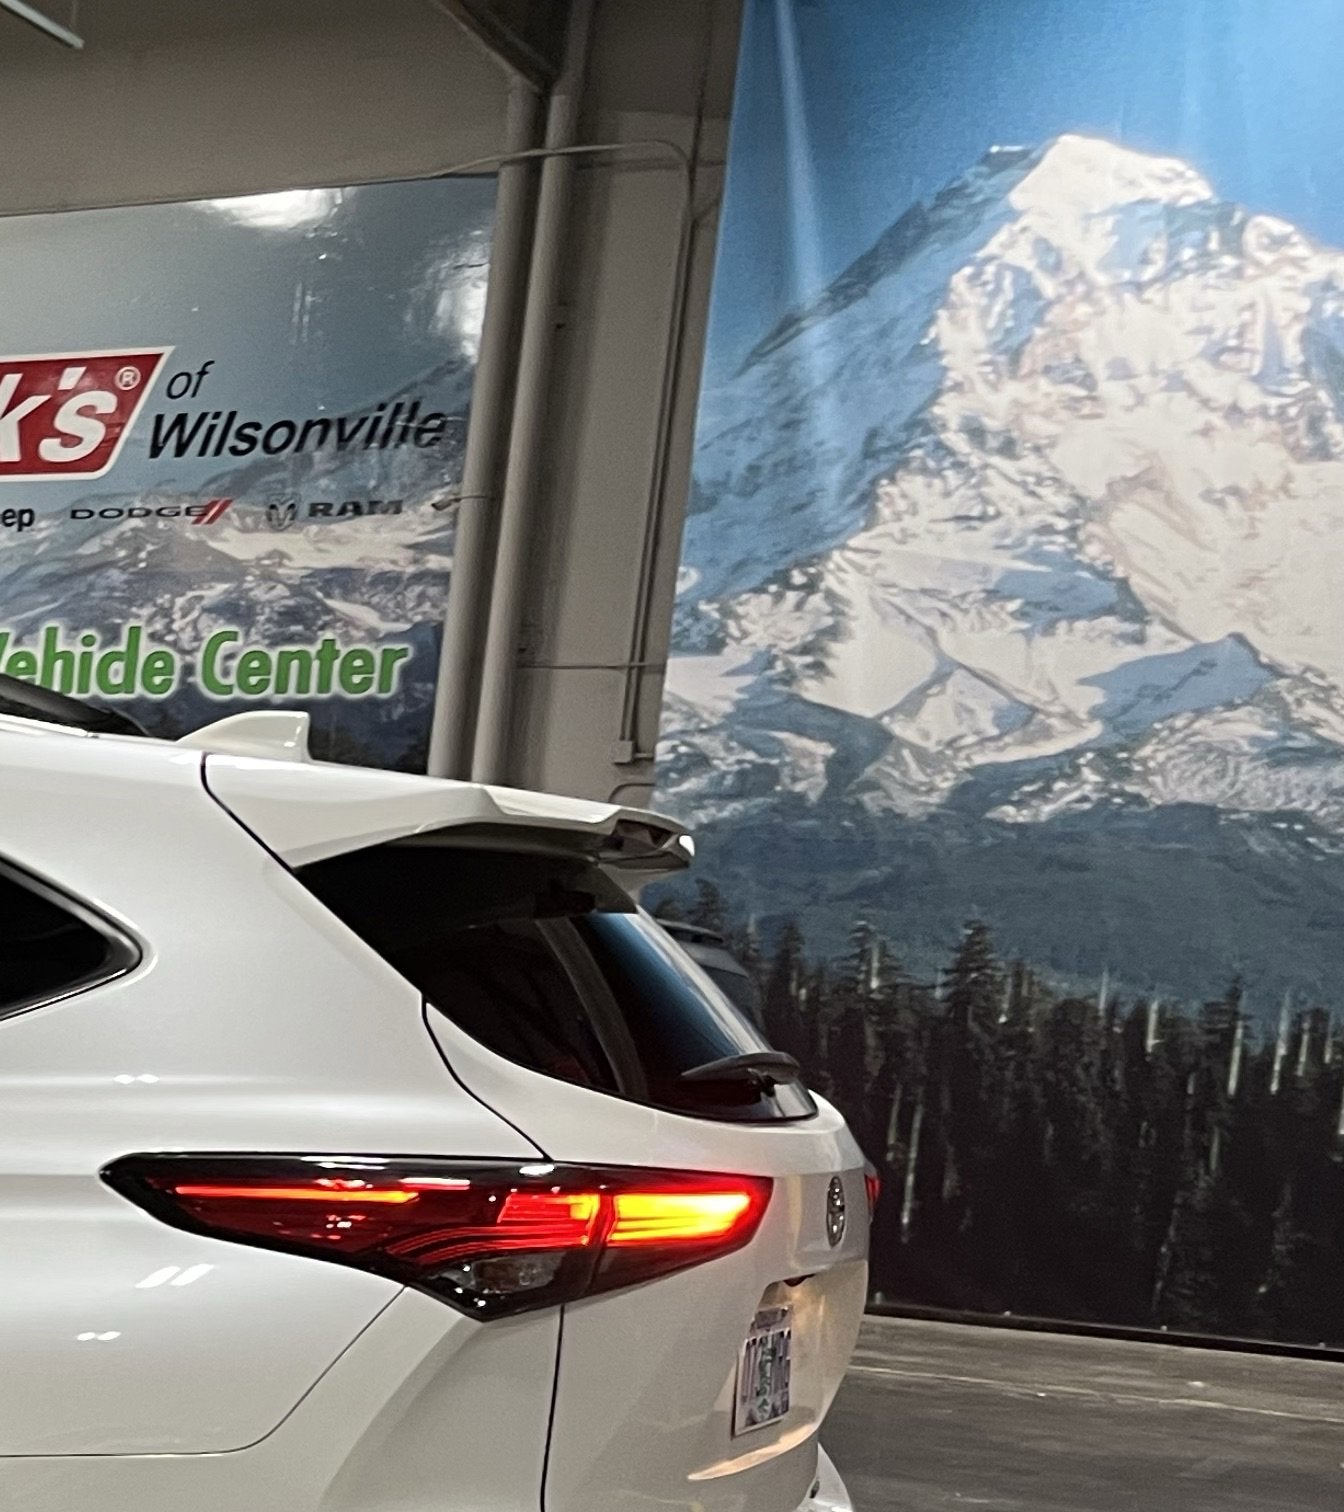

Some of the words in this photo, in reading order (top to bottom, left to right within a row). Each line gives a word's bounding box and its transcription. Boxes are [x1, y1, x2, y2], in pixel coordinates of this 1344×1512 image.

[165, 360, 215, 400] of
[148, 400, 448, 460] Wilsonville
[69, 504, 209, 520] DODGE
[307, 500, 403, 518] RAM
[201, 630, 410, 696] Center
